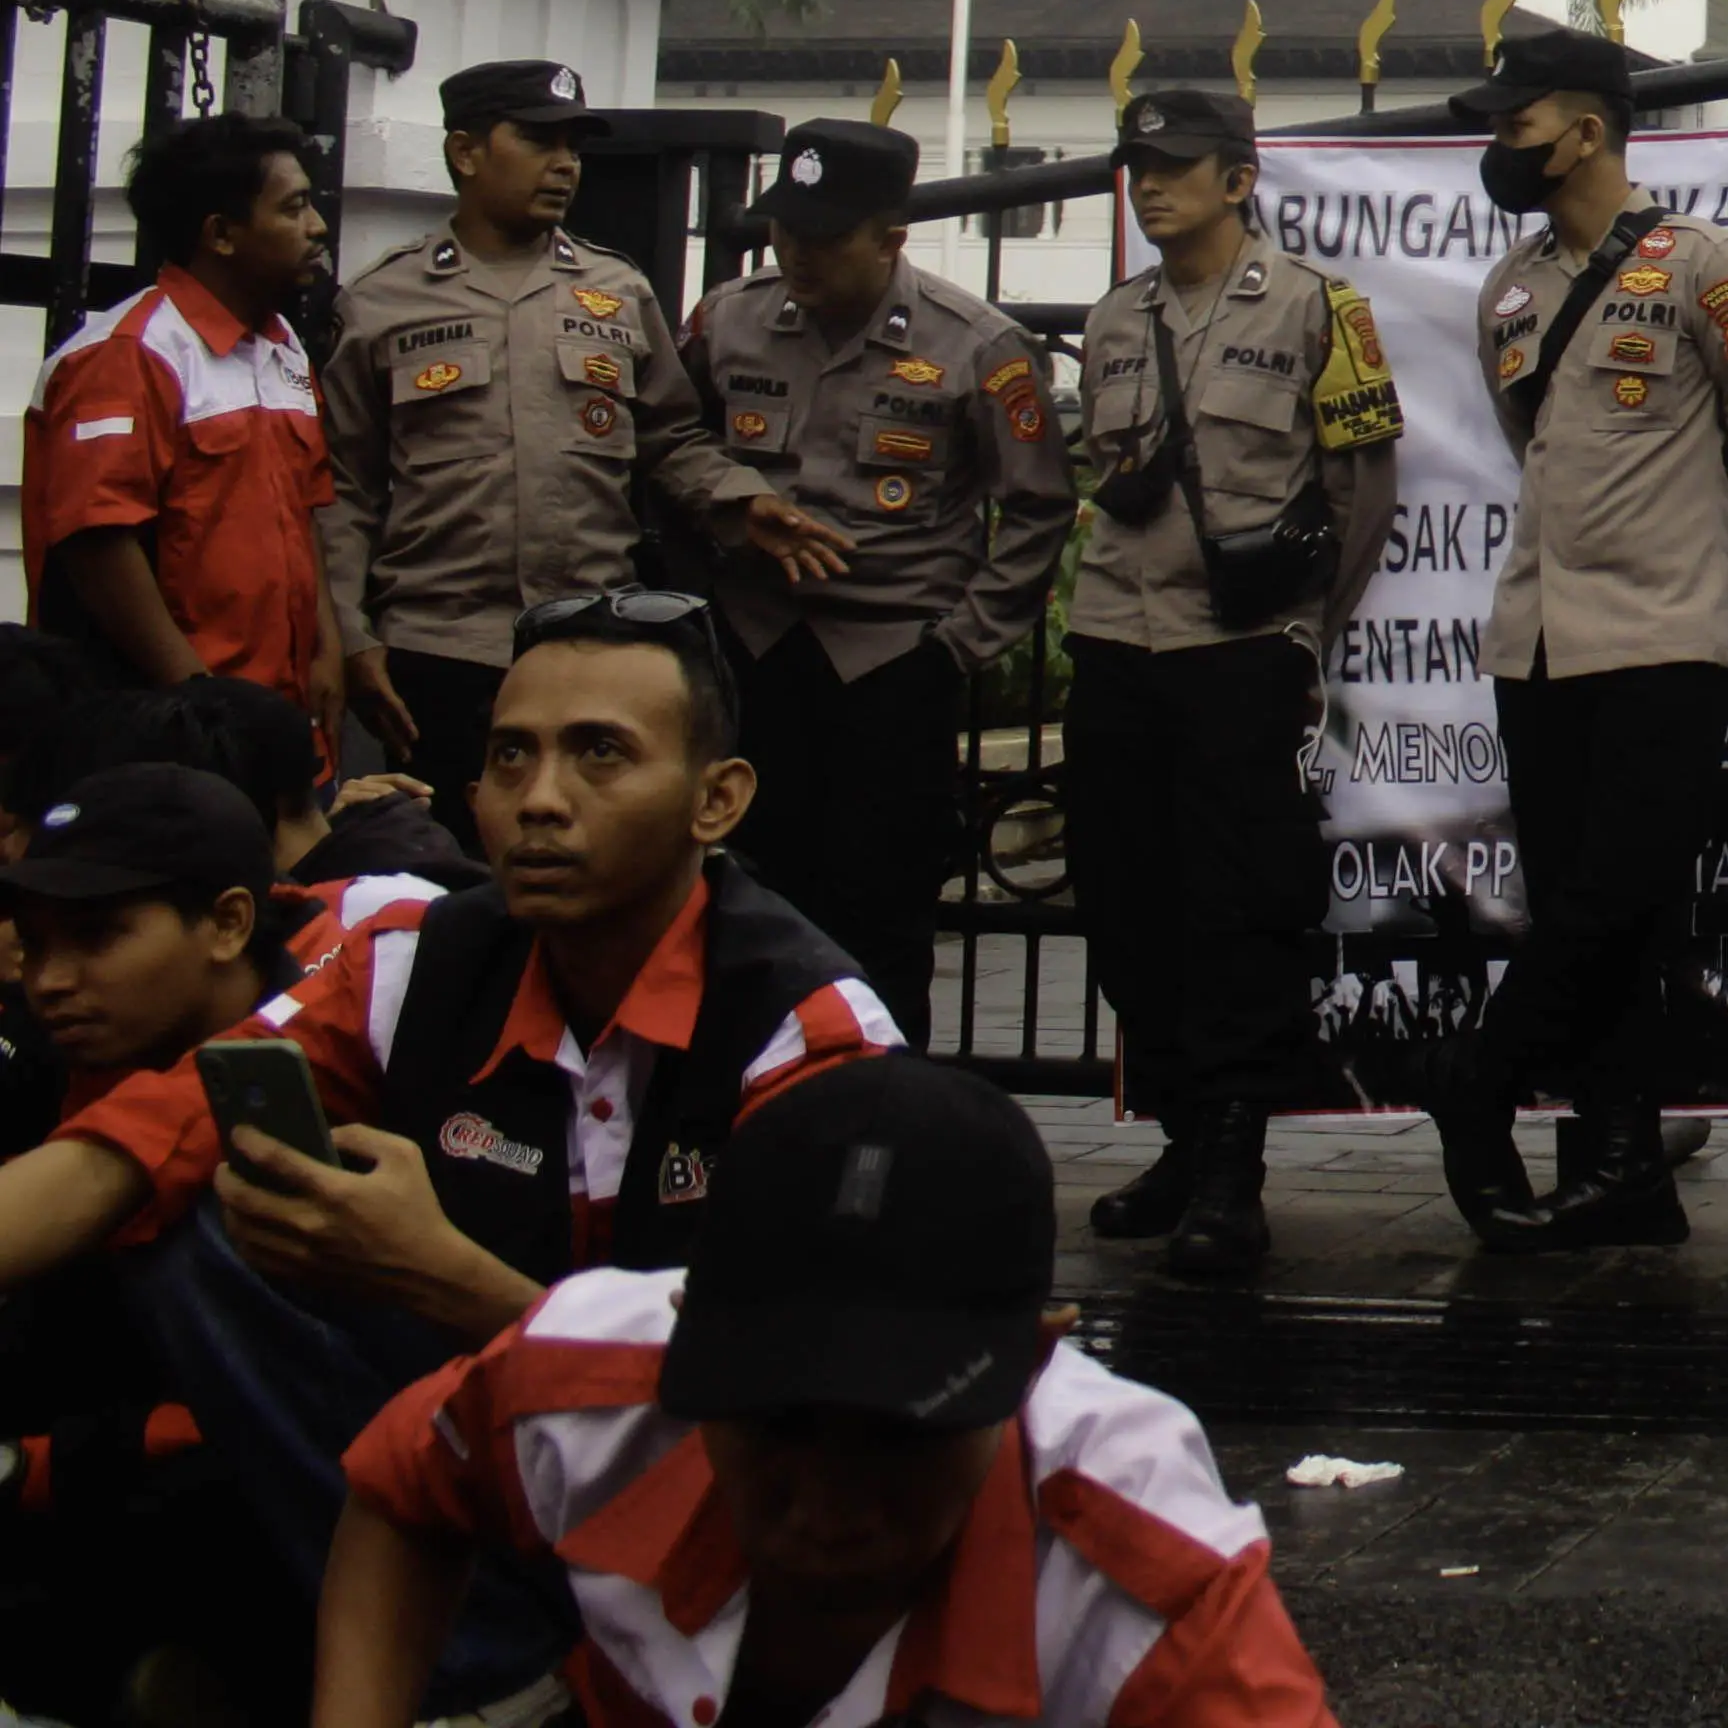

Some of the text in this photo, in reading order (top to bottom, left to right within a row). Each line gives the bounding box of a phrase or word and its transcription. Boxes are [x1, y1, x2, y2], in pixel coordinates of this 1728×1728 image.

[1602, 302, 1676, 328] POLRI
[563, 317, 632, 346] POLRI
[1222, 346, 1296, 376] POLRI
[1384, 503, 1467, 573] SAK
[1332, 840, 1448, 901] OLAK
[1464, 840, 1517, 897] PP
